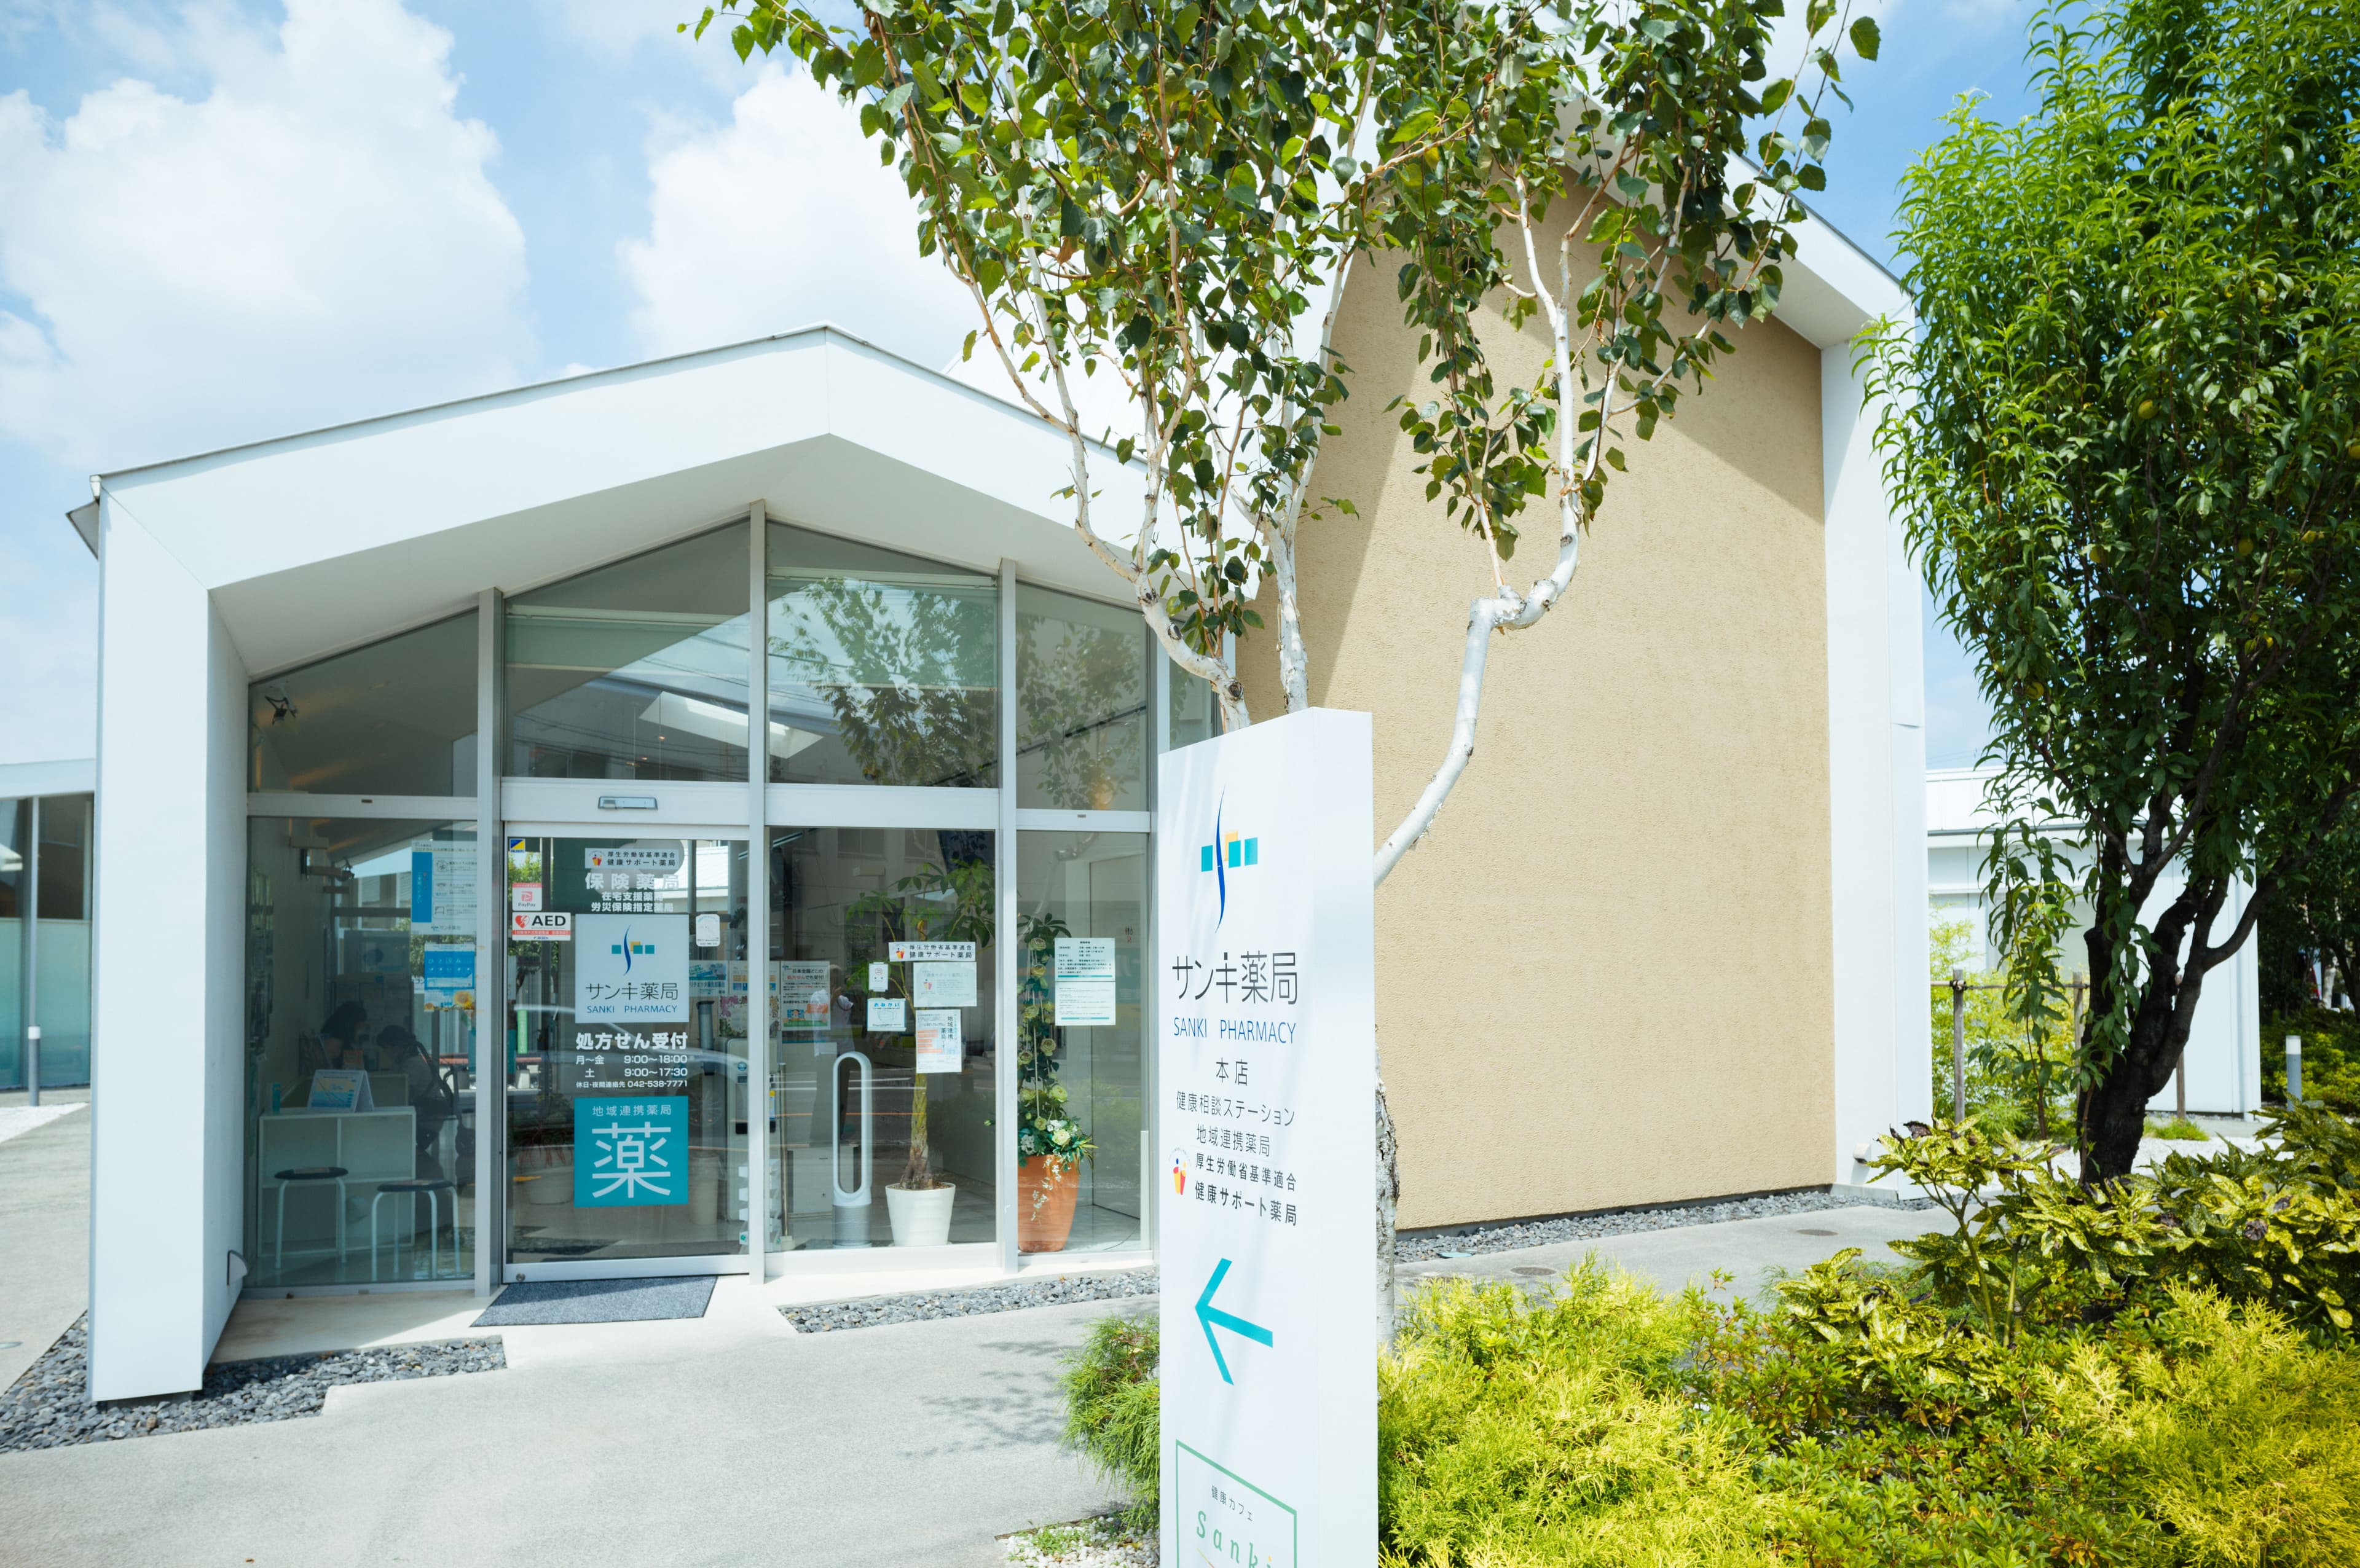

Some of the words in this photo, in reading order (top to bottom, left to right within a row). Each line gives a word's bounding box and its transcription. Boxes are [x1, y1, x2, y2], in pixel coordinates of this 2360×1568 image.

[584, 872, 679, 890] 保険薬局
[591, 902, 674, 912] 労災保険指定薬局
[532, 915, 566, 927] AED
[1172, 950, 1298, 1005] サンキ薬局
[585, 982, 678, 1001] サンキ薬局
[624, 1005, 678, 1013] PHARMACY
[576, 1032, 688, 1051] 処方せん受付
[1174, 1017, 1208, 1038] SANKI
[1220, 1019, 1297, 1045] PHARMACY
[584, 1068, 595, 1078] 土
[1216, 1057, 1249, 1086] 本店
[592, 1104, 672, 1116] 地域連携薬局
[1176, 1091, 1295, 1127] 健康相談ステーション
[1196, 1123, 1270, 1157] 地域連携薬局
[592, 1121, 672, 1199] 薬
[1196, 1153, 1296, 1192] 厚生労働省基準適合
[1195, 1180, 1297, 1226] 健康サポート薬局
